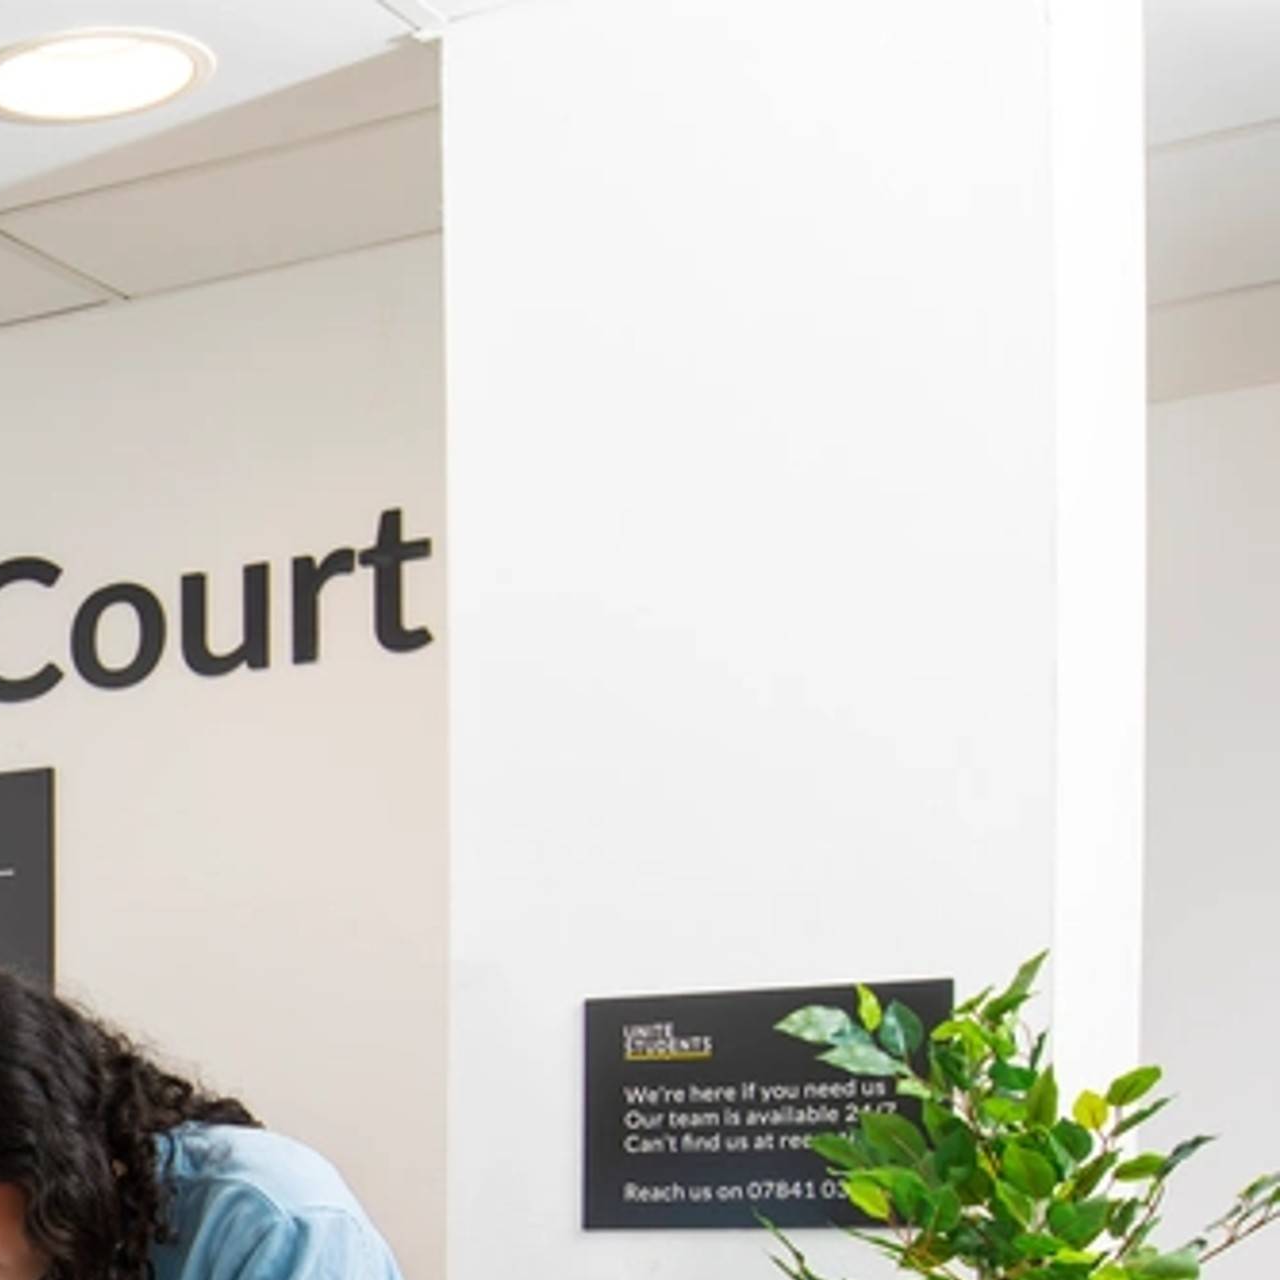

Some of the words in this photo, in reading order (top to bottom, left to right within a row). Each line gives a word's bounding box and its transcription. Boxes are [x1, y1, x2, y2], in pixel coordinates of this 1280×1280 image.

[622, 1022, 674, 1038] UNITE
[623, 1036, 713, 1056] STUDENTS
[623, 1086, 686, 1104] We're
[690, 1084, 737, 1102] here
[742, 1082, 756, 1100] if
[760, 1084, 800, 1104] you
[803, 1080, 857, 1098] need
[861, 1081, 886, 1097] us
[623, 1109, 665, 1130] Our
[668, 1109, 720, 1127] team
[723, 1107, 741, 1126] is
[745, 1104, 839, 1126] available
[623, 1134, 679, 1153] Can't
[680, 1132, 722, 1152] find
[726, 1133, 749, 1150] us
[753, 1132, 775, 1150] at
[623, 1180, 686, 1203] Reach
[689, 1183, 713, 1202] us
[715, 1183, 743, 1200] on
[746, 1180, 816, 1200] 07841
